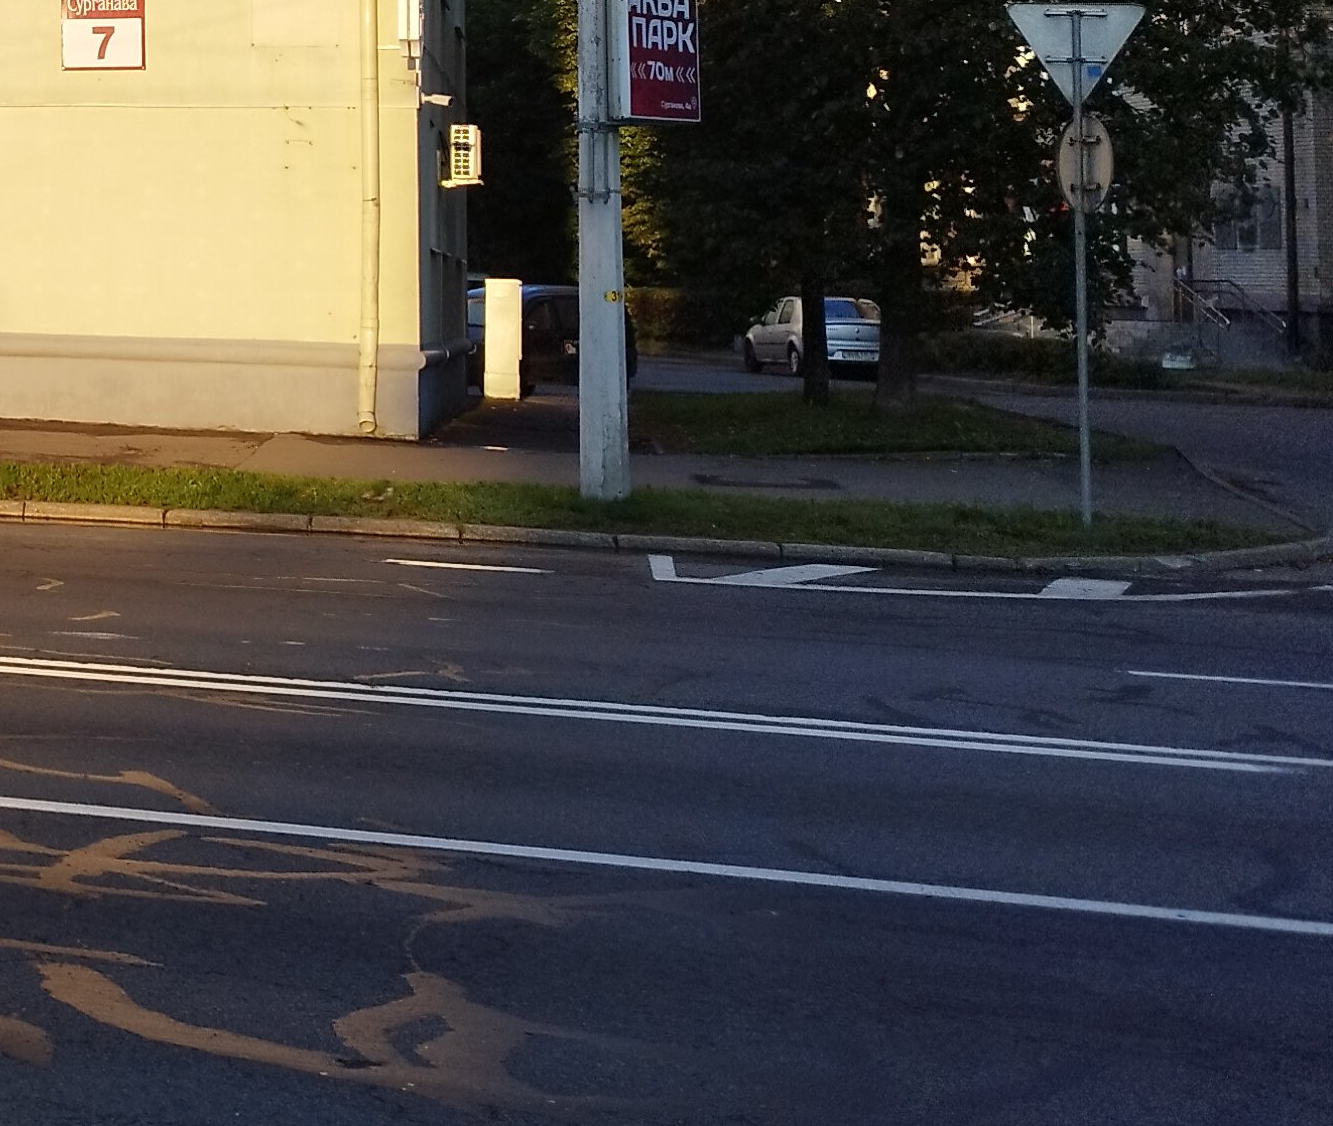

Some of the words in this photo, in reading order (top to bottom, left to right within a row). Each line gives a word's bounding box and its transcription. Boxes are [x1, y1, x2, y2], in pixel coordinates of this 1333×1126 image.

[92, 26, 115, 60] 7
[632, 16, 695, 53] ПАРК
[646, 60, 674, 83] 70м
